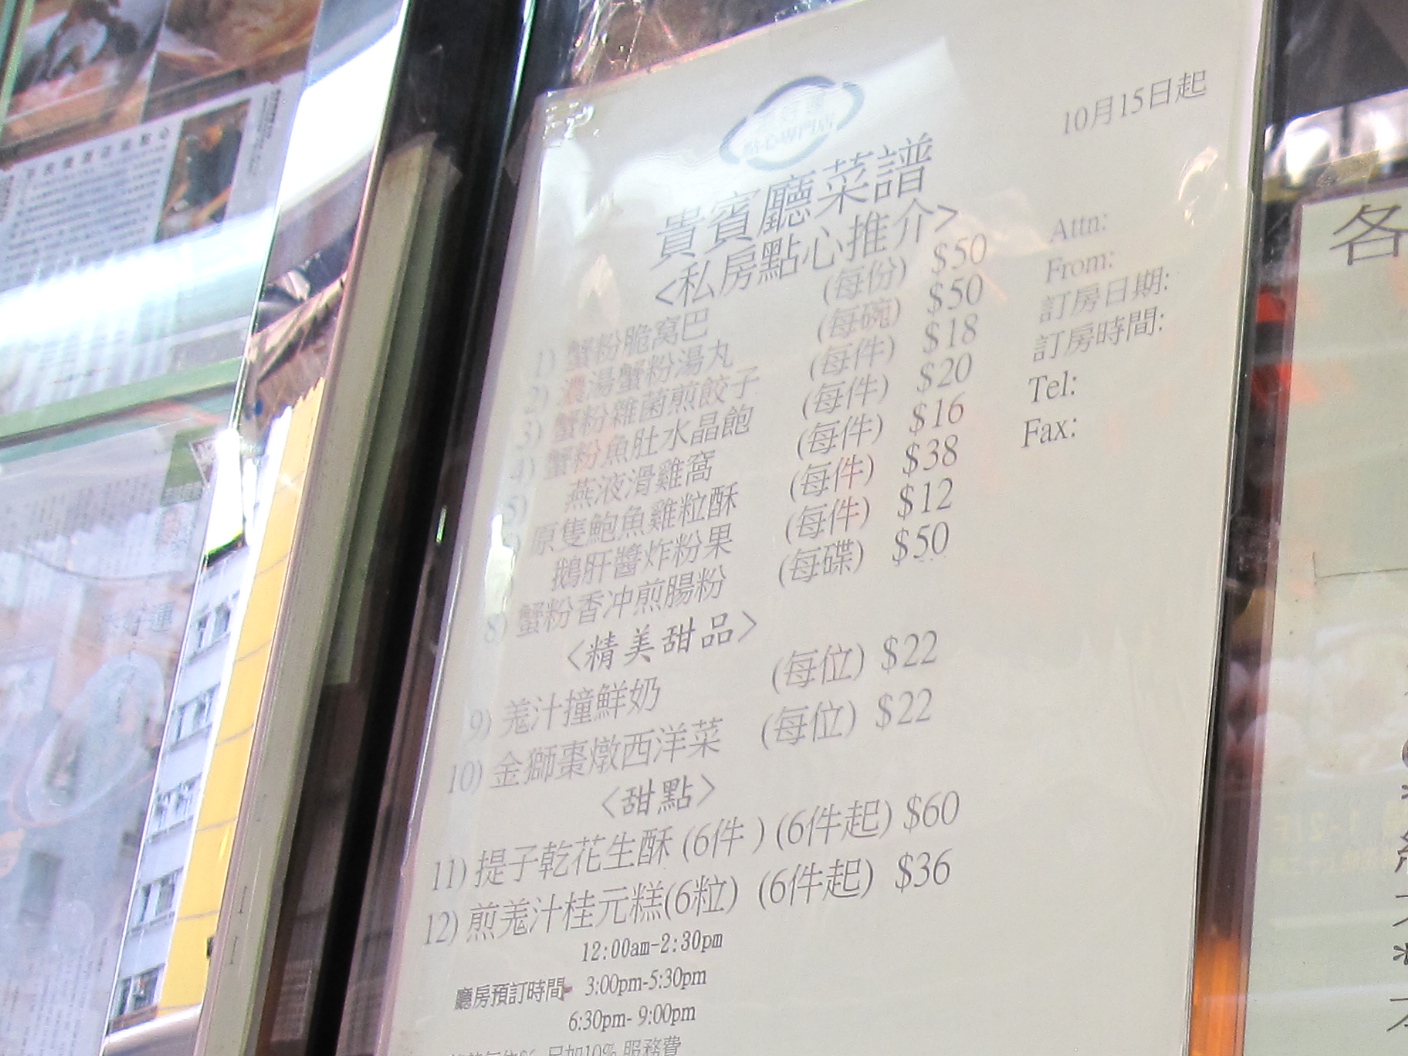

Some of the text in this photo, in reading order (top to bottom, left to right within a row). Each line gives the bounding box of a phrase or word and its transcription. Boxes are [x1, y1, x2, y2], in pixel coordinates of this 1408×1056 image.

[1061, 69, 1208, 137] 10月15日起
[650, 132, 933, 271] 貴賓廳菜譜
[1048, 211, 1107, 243] Attn:
[931, 235, 988, 274] $50
[1046, 249, 1115, 284] From:
[927, 274, 984, 314] $50
[1037, 266, 1170, 323] 訂房日期:
[809, 336, 897, 381] (每件)
[921, 313, 978, 353] $18
[1033, 308, 1165, 363] 訂房時間:
[802, 375, 889, 420] (每件)
[918, 352, 973, 393] $20
[1027, 371, 1078, 406] Tel:
[795, 414, 883, 460] (每件)
[908, 391, 964, 431] $16
[1020, 416, 1078, 450] Fax:
[789, 455, 875, 502] (每件)
[901, 437, 959, 475] $38
[785, 496, 870, 544] (每件)
[896, 477, 954, 518] $12
[891, 521, 950, 563] $50
[771, 643, 865, 693] (每位)
[880, 630, 940, 672] $22
[446, 758, 484, 797] 10)
[760, 700, 857, 750] (每位)
[875, 688, 933, 730] $22
[430, 855, 468, 893] 11)
[775, 799, 893, 850] (6件起)
[901, 791, 960, 832] $60
[422, 910, 460, 949] 12)
[758, 856, 875, 909] (6件起)
[895, 848, 952, 892] $36
[580, 929, 724, 963] 12:00am-2:30pm
[584, 966, 708, 997] 3:00pm-5:30pm
[636, 1000, 697, 1030] 9:00pm
